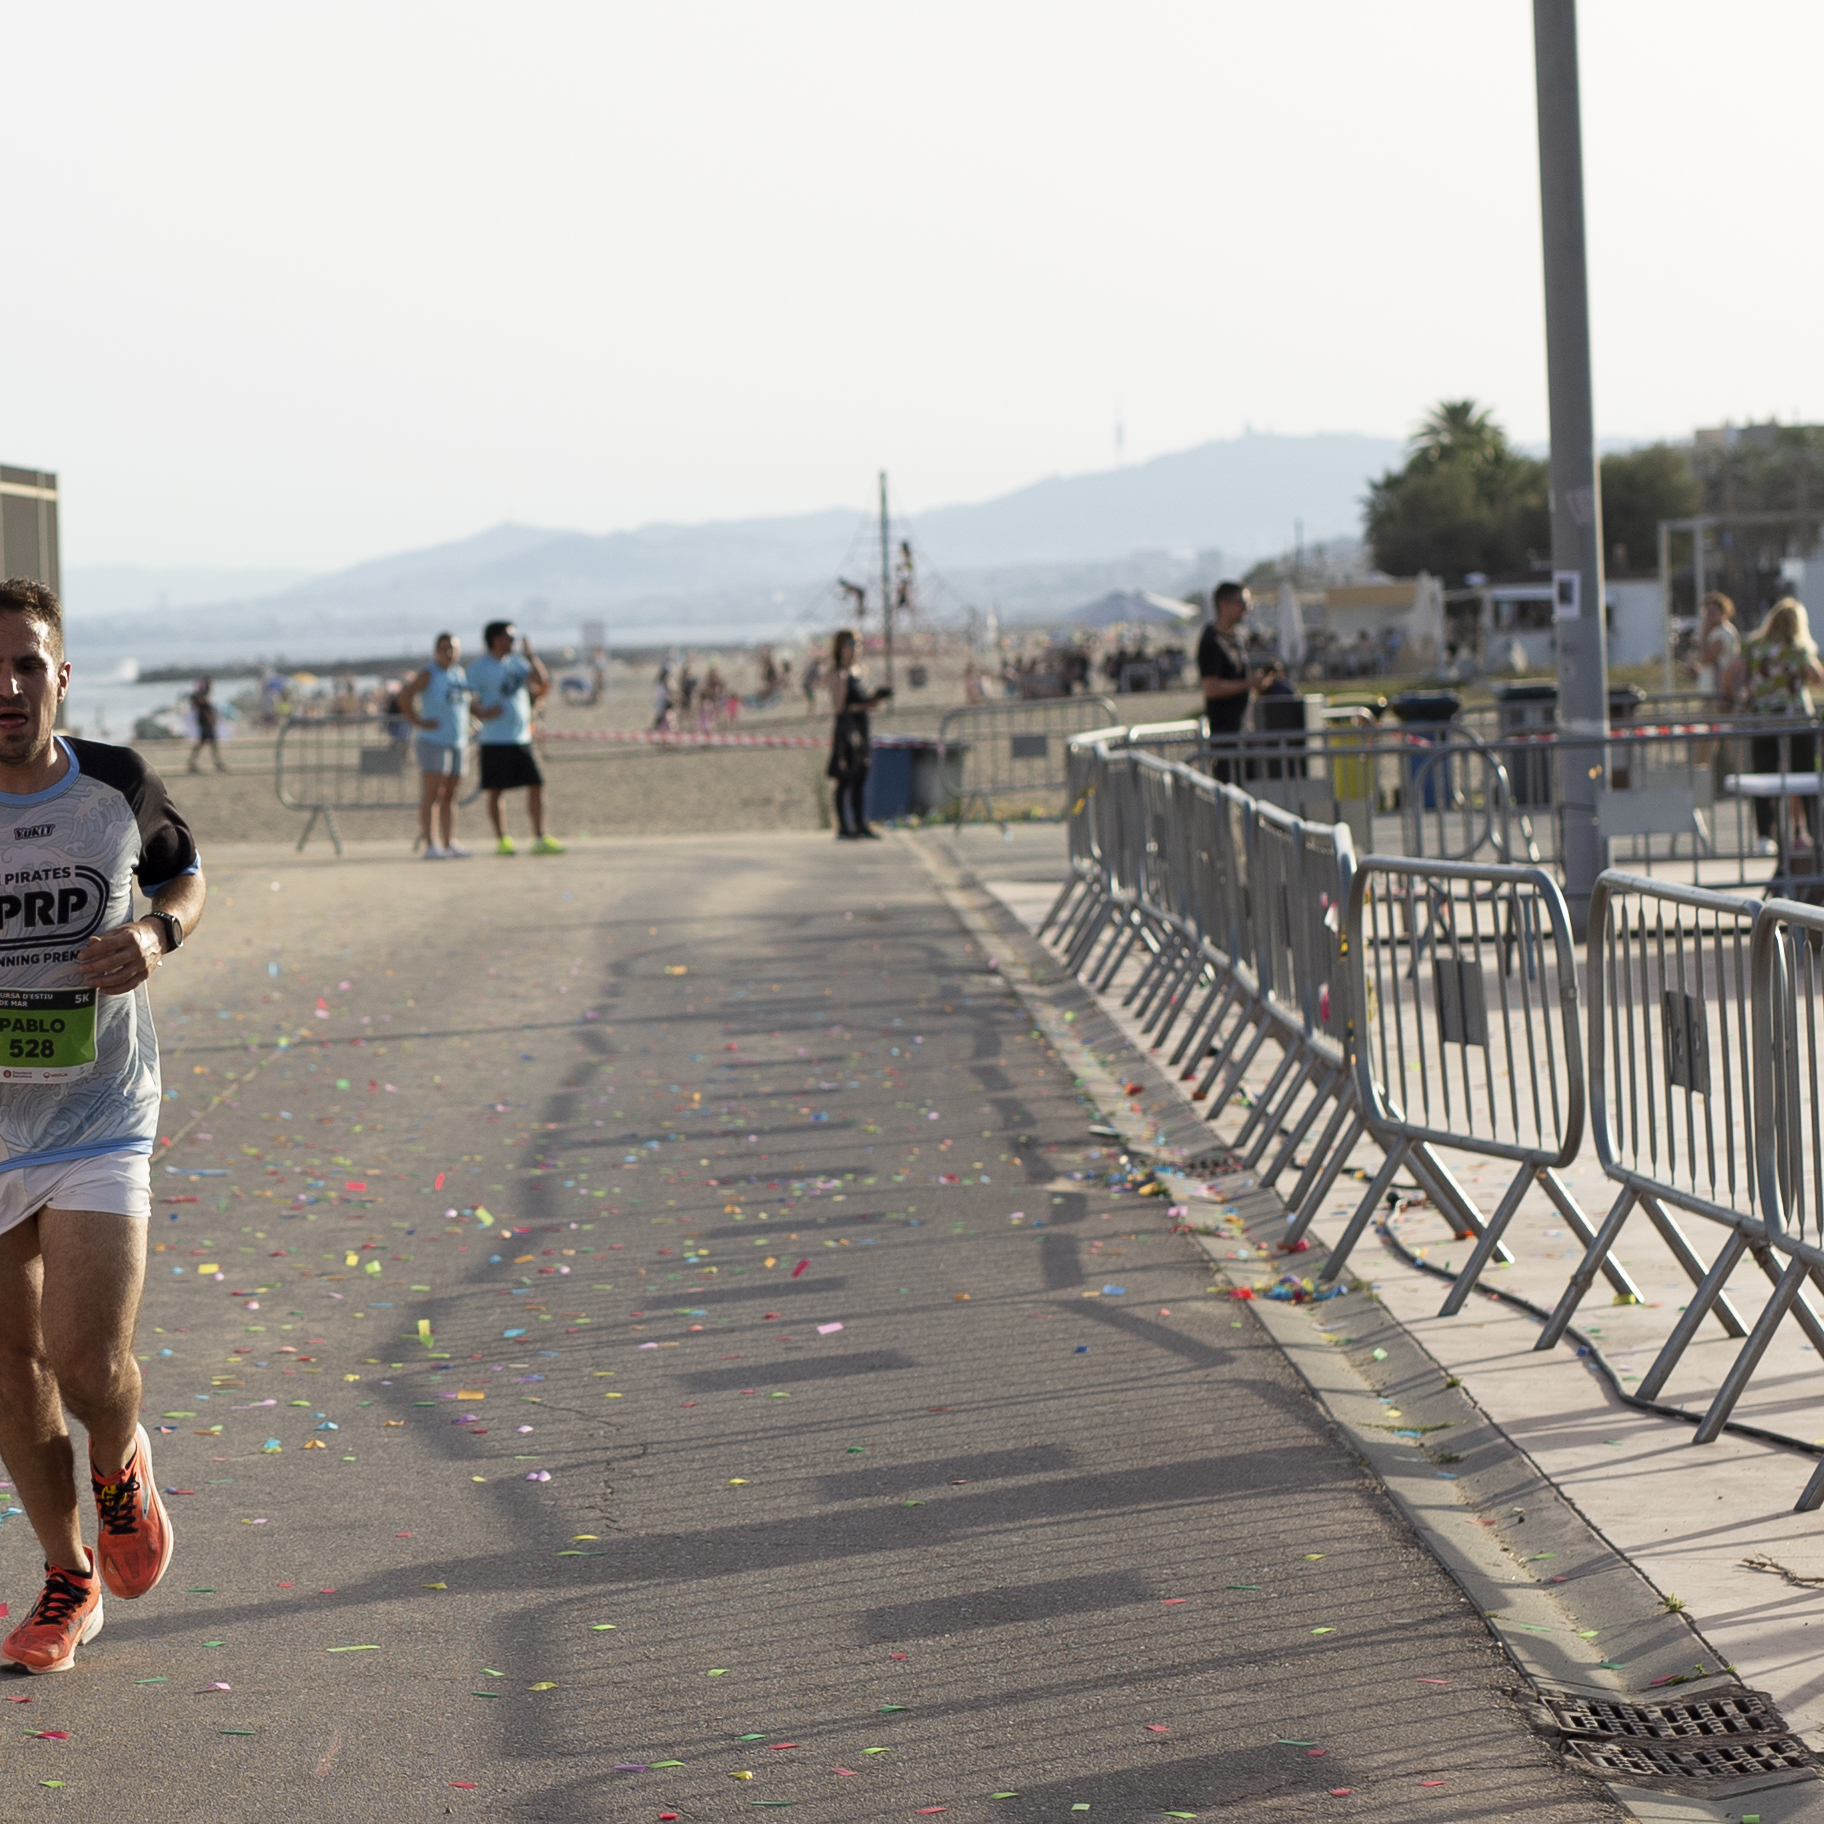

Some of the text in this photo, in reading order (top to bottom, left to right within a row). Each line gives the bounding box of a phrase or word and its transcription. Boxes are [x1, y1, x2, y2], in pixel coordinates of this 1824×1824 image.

[4, 866, 72, 885] PIRATES
[74, 993, 90, 1004] 5K
[9, 1038, 55, 1058] 528
